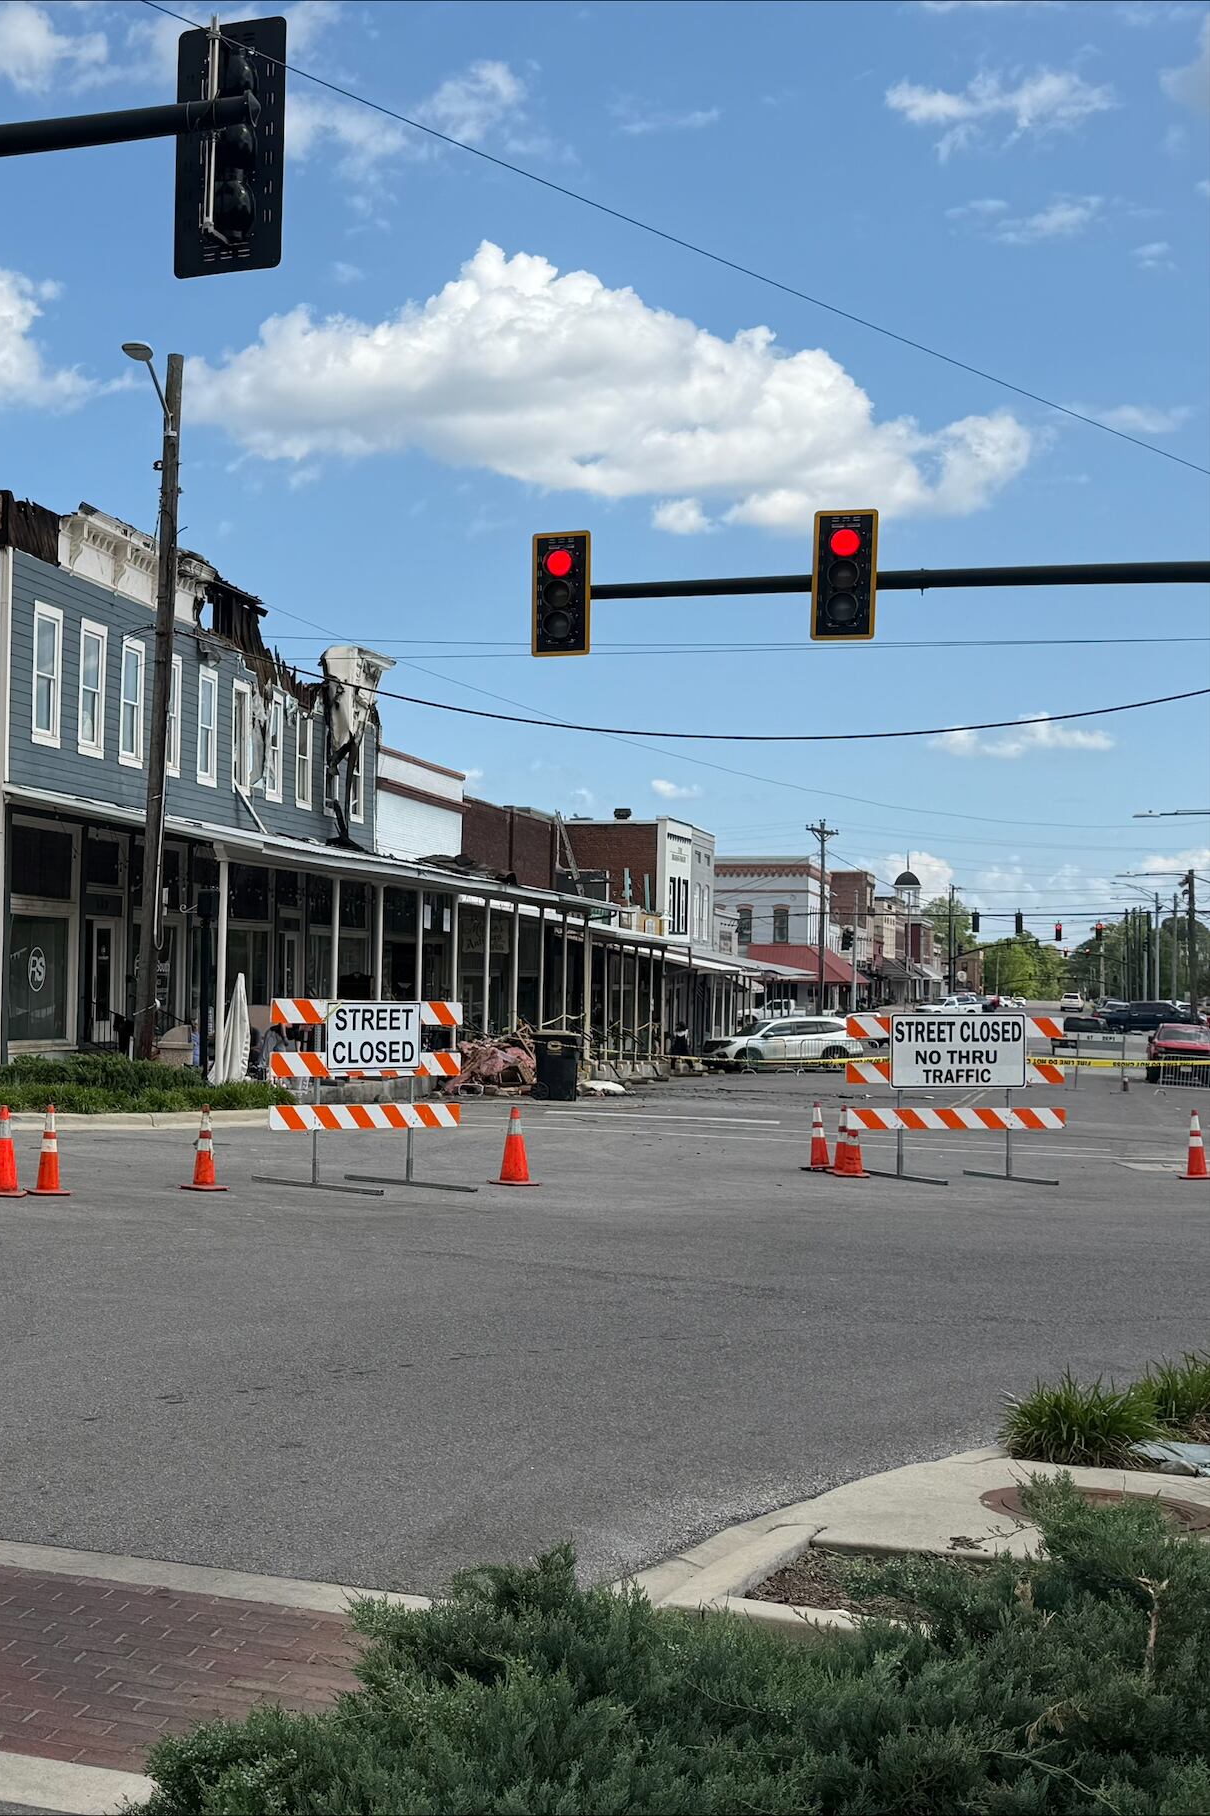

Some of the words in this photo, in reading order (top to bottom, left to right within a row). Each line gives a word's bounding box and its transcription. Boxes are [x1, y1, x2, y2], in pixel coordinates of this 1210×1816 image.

[335, 1008, 414, 1031] STREET
[895, 1021, 956, 1043] STREET
[960, 1021, 1022, 1043] CLOSED
[332, 1041, 415, 1064] CLOSED
[915, 1050, 941, 1065] NO
[947, 1050, 998, 1065] THRU
[923, 1068, 992, 1083] TRAFFIC
